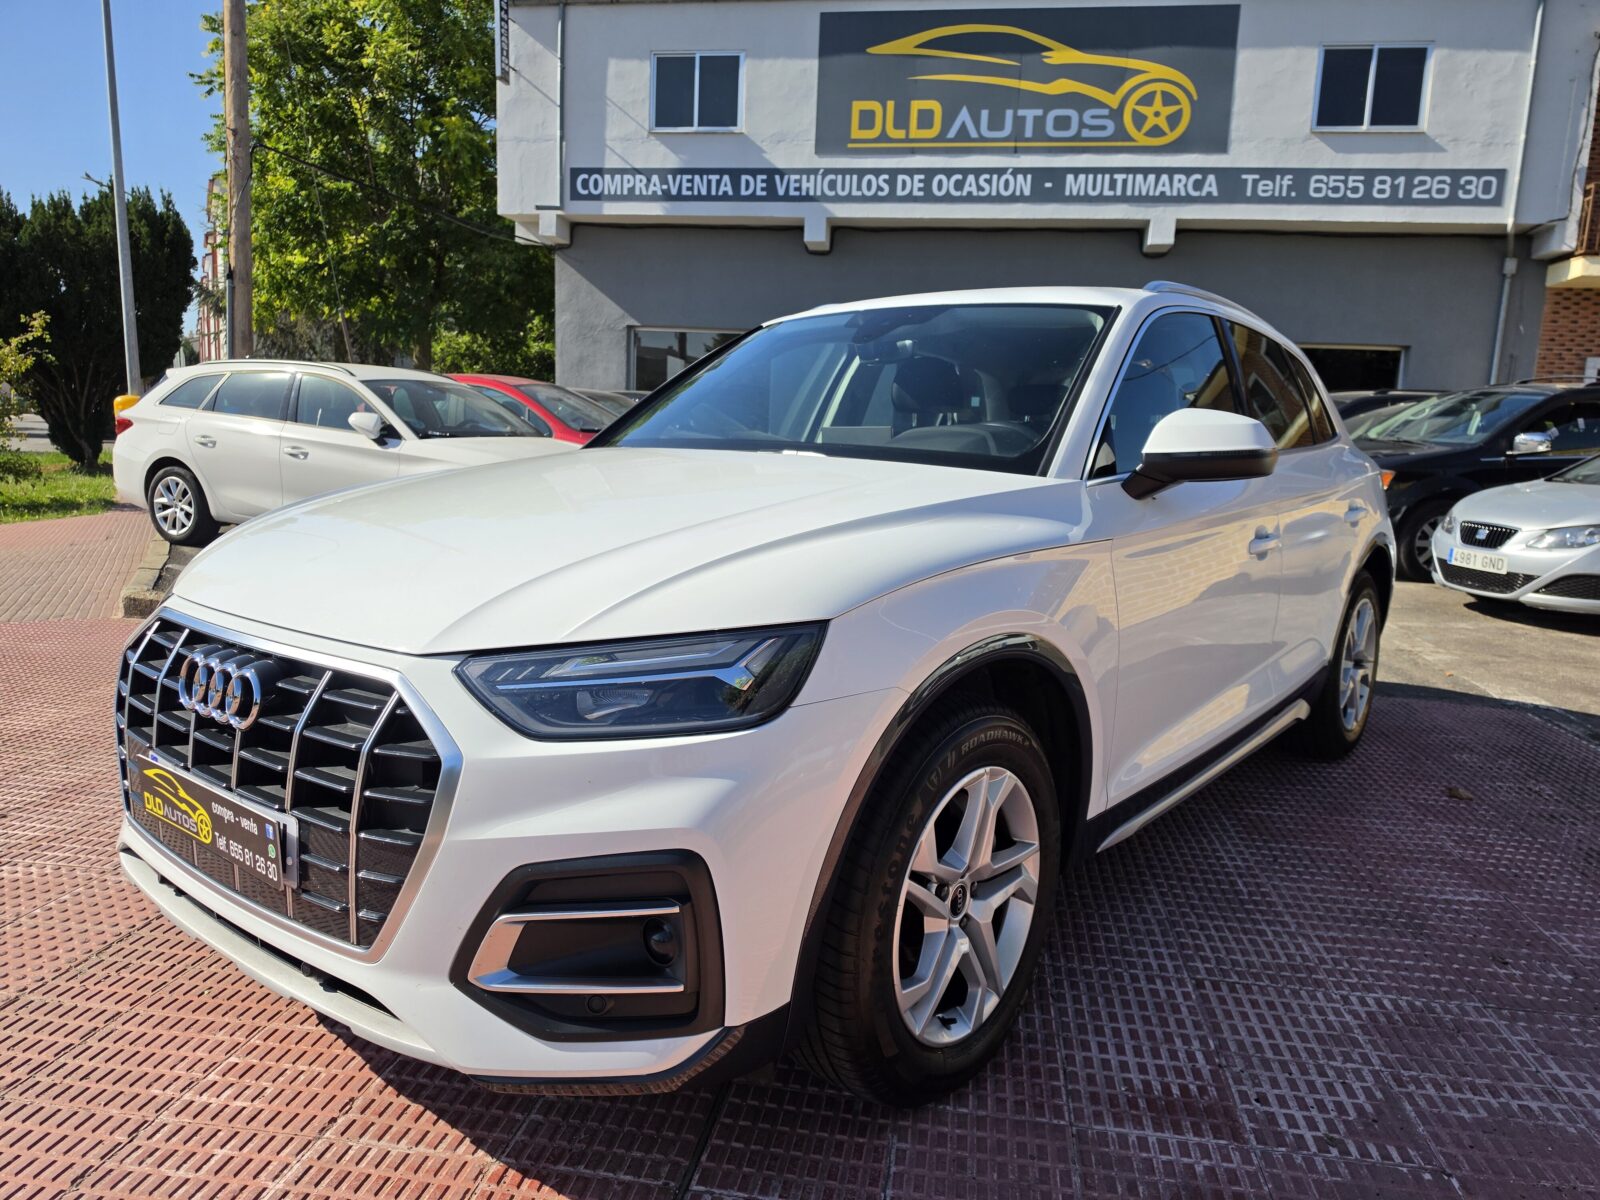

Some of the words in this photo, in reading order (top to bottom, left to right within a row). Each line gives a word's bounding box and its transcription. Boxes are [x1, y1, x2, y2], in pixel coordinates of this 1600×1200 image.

[850, 99, 943, 139] DLD
[946, 105, 1116, 139] AUTOS
[576, 173, 734, 196] COMPRA-VENTA
[740, 174, 768, 196] DE
[774, 168, 890, 197] VEHÍCULOS
[896, 174, 925, 197] DE
[932, 168, 1032, 197] OCASIÓN
[1064, 173, 1219, 197] MULTIMARCA
[1241, 174, 1296, 198] Telf.
[1308, 175, 1365, 198] 655
[1457, 176, 1498, 199] 30
[1481, 555, 1505, 571] GND
[144, 791, 164, 816] DLD
[164, 804, 197, 833] AUTOS
[211, 802, 235, 823] compra
[240, 817, 258, 835] venta
[229, 840, 243, 862] 655
[244, 848, 254, 868] 81
[255, 855, 266, 875] 26
[267, 861, 278, 881] 30
